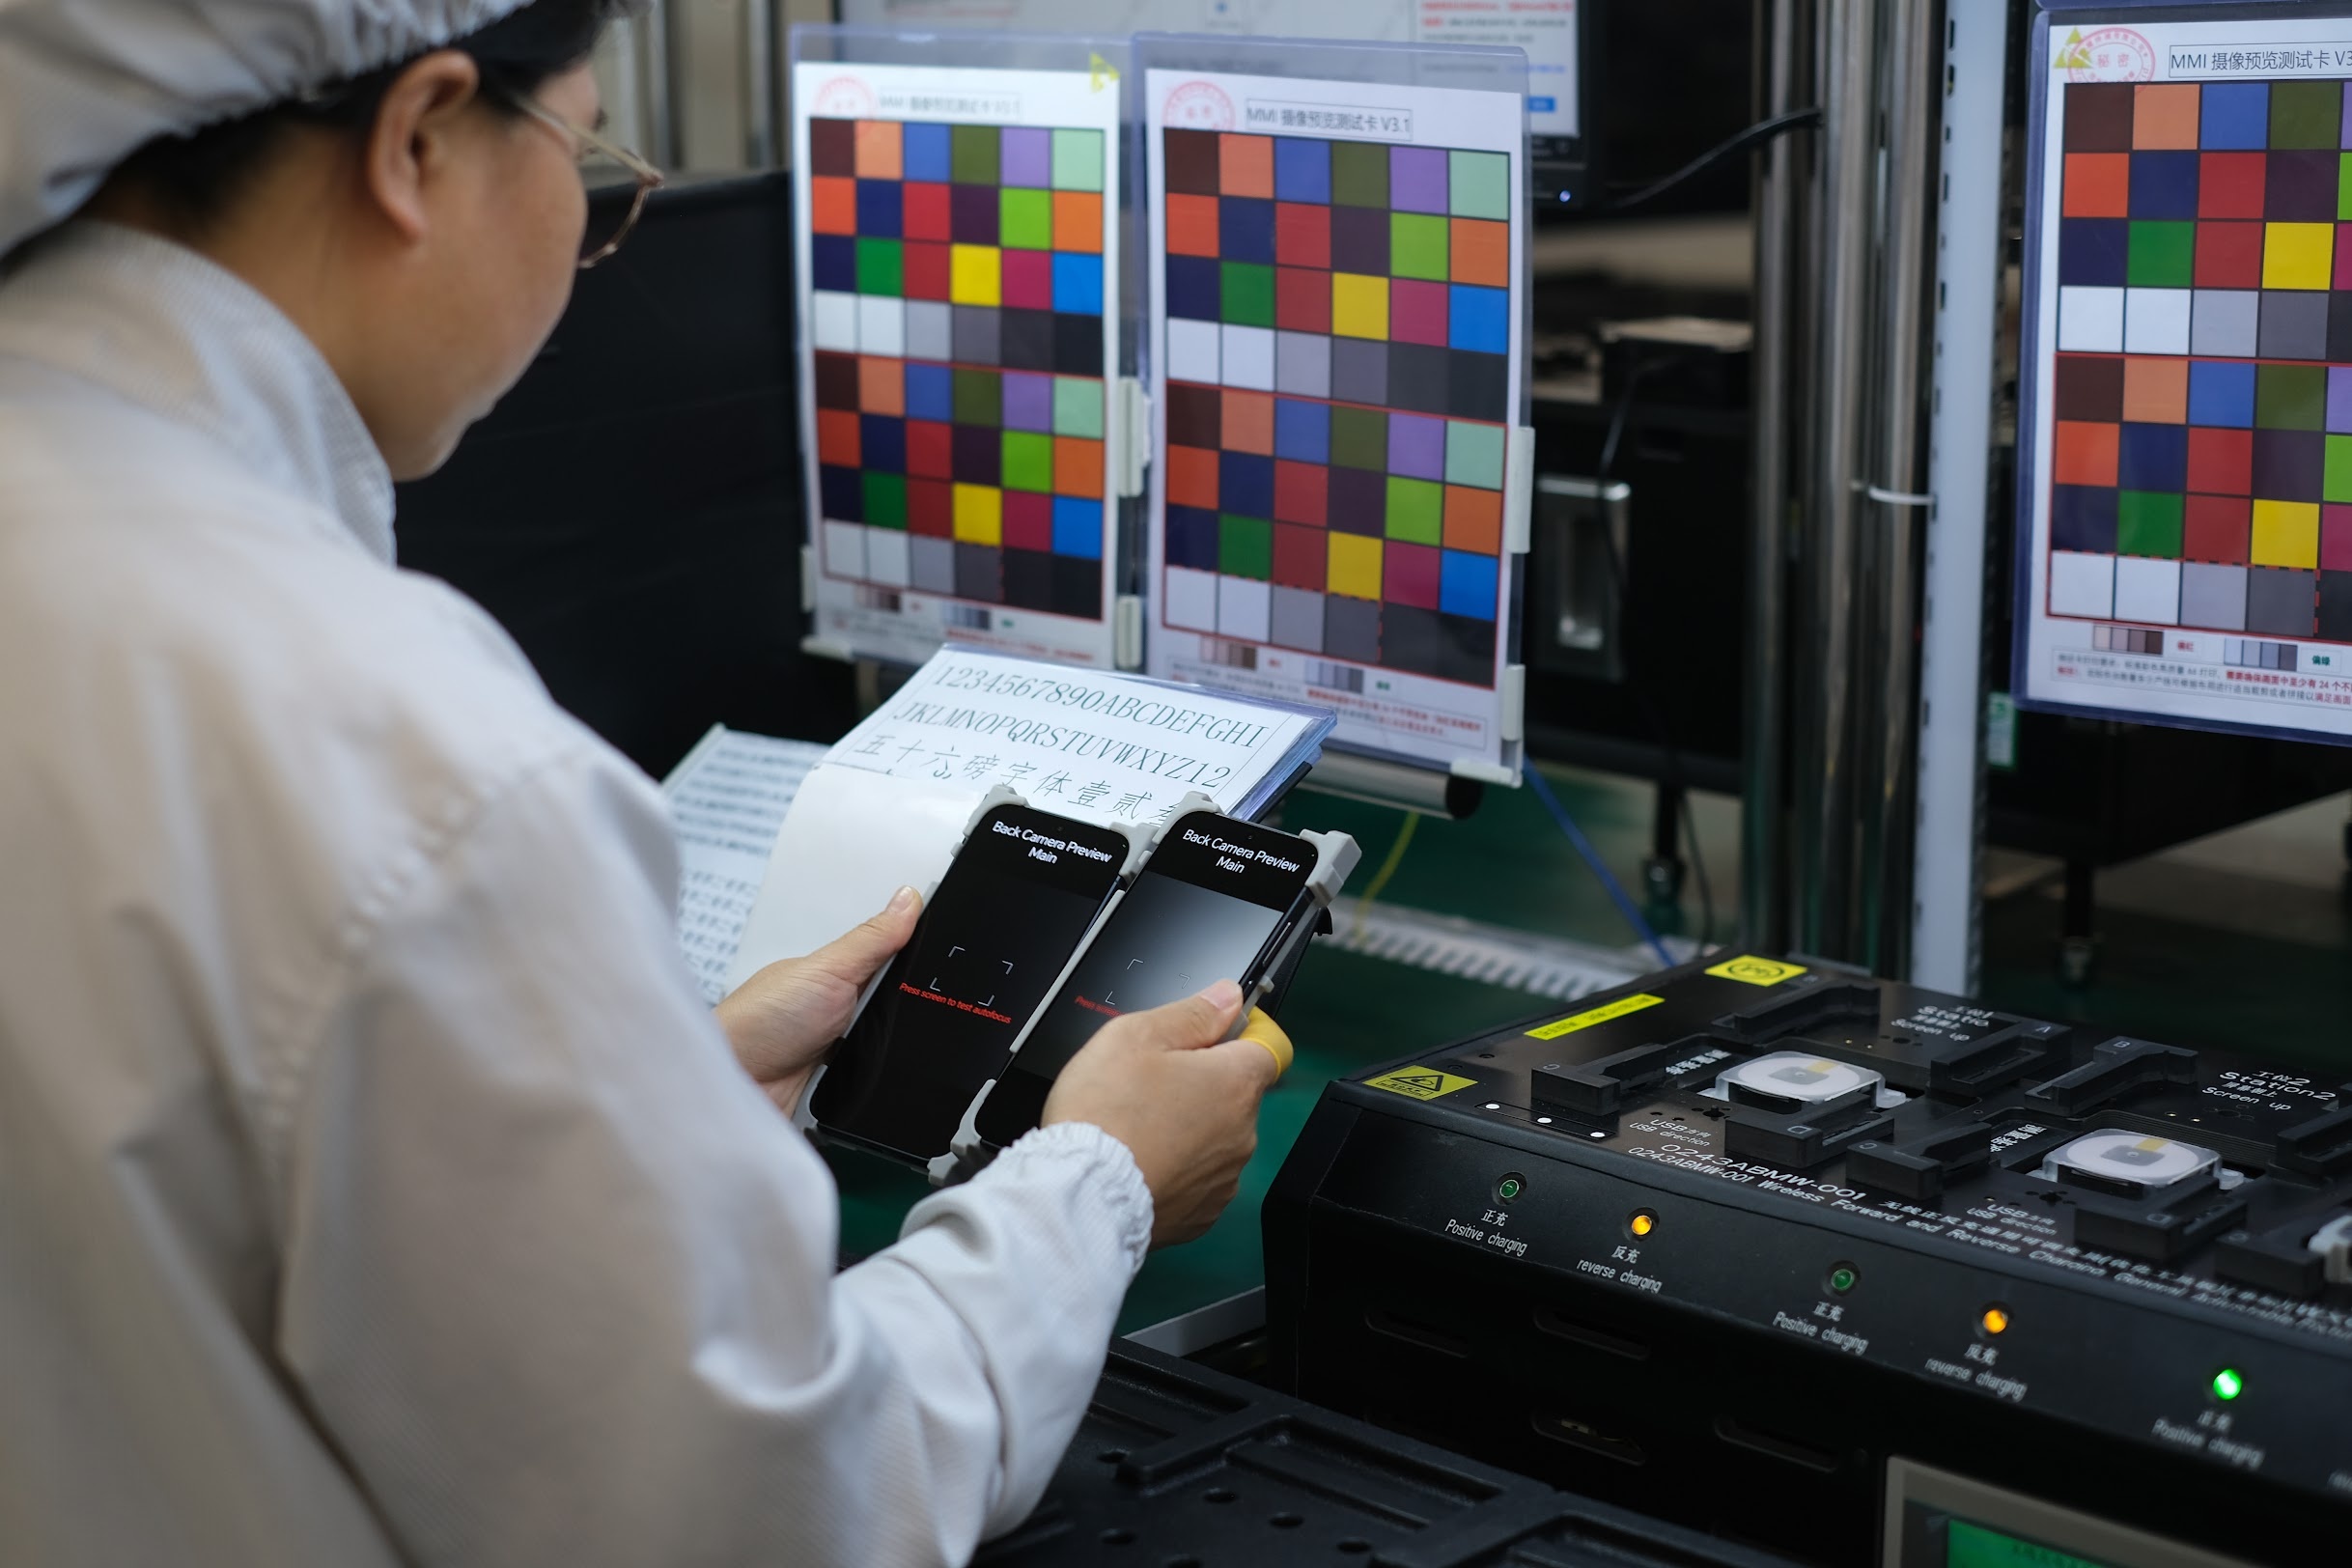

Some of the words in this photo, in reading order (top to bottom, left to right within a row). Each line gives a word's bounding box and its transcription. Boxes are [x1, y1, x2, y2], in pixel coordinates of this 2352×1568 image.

[2170, 53, 2207, 70] MMI
[2211, 49, 2331, 70] 摄像预览测试卡
[1246, 107, 1276, 123] MMI
[1281, 109, 1378, 131] 摄像预览测试卡
[1381, 118, 1410, 133] V3.1
[933, 666, 1270, 748] 1234567890ABCDEFGHI
[893, 702, 1232, 788] JKLMNOPQRSTUVWXYZ12
[992, 820, 1022, 839] Back
[1022, 828, 1066, 851] Camera
[1066, 840, 1113, 863] Preview
[1027, 846, 1059, 864] Main
[1182, 828, 1213, 847] Back
[1211, 837, 1254, 859] Camera
[1254, 850, 1301, 873] Preview
[1215, 855, 1246, 874] Main
[899, 982, 921, 995] Press
[920, 991, 947, 1003] screen
[946, 997, 957, 1007] to
[956, 1000, 973, 1012] test
[972, 1006, 1013, 1023] autofocus
[1075, 994, 1095, 1010] Press
[1890, 1018, 1943, 1035] Screen
[1949, 1032, 1971, 1042] up
[2219, 1071, 2337, 1101] Station2
[2252, 1070, 2310, 1086] 工位2
[2201, 1086, 2260, 1104] Screen
[2268, 1102, 2292, 1111] up
[1629, 1121, 1658, 1133] USB
[1659, 1130, 1711, 1147] direction
[1649, 1118, 1712, 1139] USB方向
[1660, 1143, 1867, 1201] 0243ABMW-001
[1627, 1146, 1756, 1184] 0243ABMW-001
[1756, 1178, 1826, 1203] Wireless
[1830, 1198, 1905, 1223] Forward
[1905, 1219, 1946, 1234] and
[1945, 1227, 2022, 1254] Reverse
[1480, 1208, 1509, 1227] 正充
[1966, 1207, 1998, 1219] USB
[2000, 1217, 2058, 1236] direction
[1444, 1218, 1485, 1242] Positive
[1487, 1231, 1529, 1257] charging
[1610, 1245, 1641, 1265] 反充
[1576, 1258, 1616, 1279] reverse
[1619, 1269, 1664, 1294] charging
[1811, 1301, 1845, 1323] 正充
[1772, 1310, 1819, 1337] Positive
[1821, 1328, 1870, 1357] charging
[1923, 1358, 1973, 1382] reverse
[1974, 1370, 2029, 1402] charging
